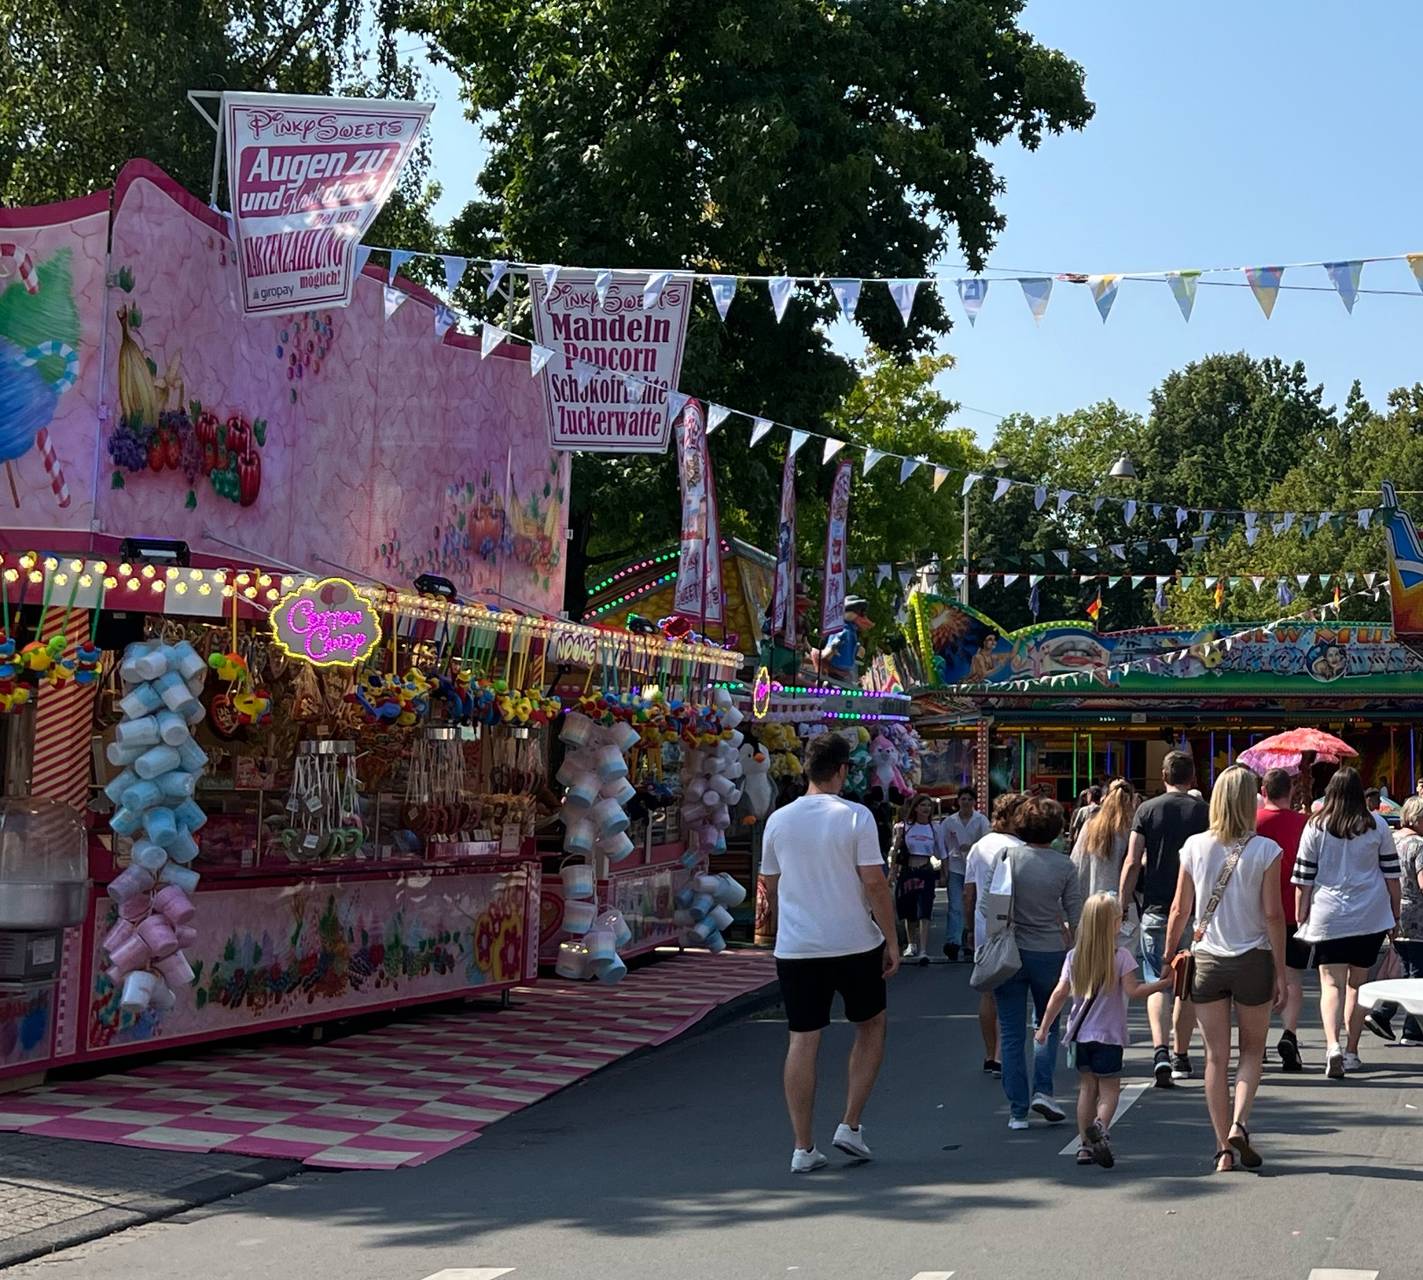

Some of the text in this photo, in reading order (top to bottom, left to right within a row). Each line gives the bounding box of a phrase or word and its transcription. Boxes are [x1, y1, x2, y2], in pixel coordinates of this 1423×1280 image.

[248, 149, 390, 188] Augen zu
[241, 184, 284, 211] und
[261, 285, 294, 301] giropay
[300, 270, 341, 289] möglich!
[552, 313, 670, 342] Mandeln
[558, 406, 661, 437] Zuckerwatte
